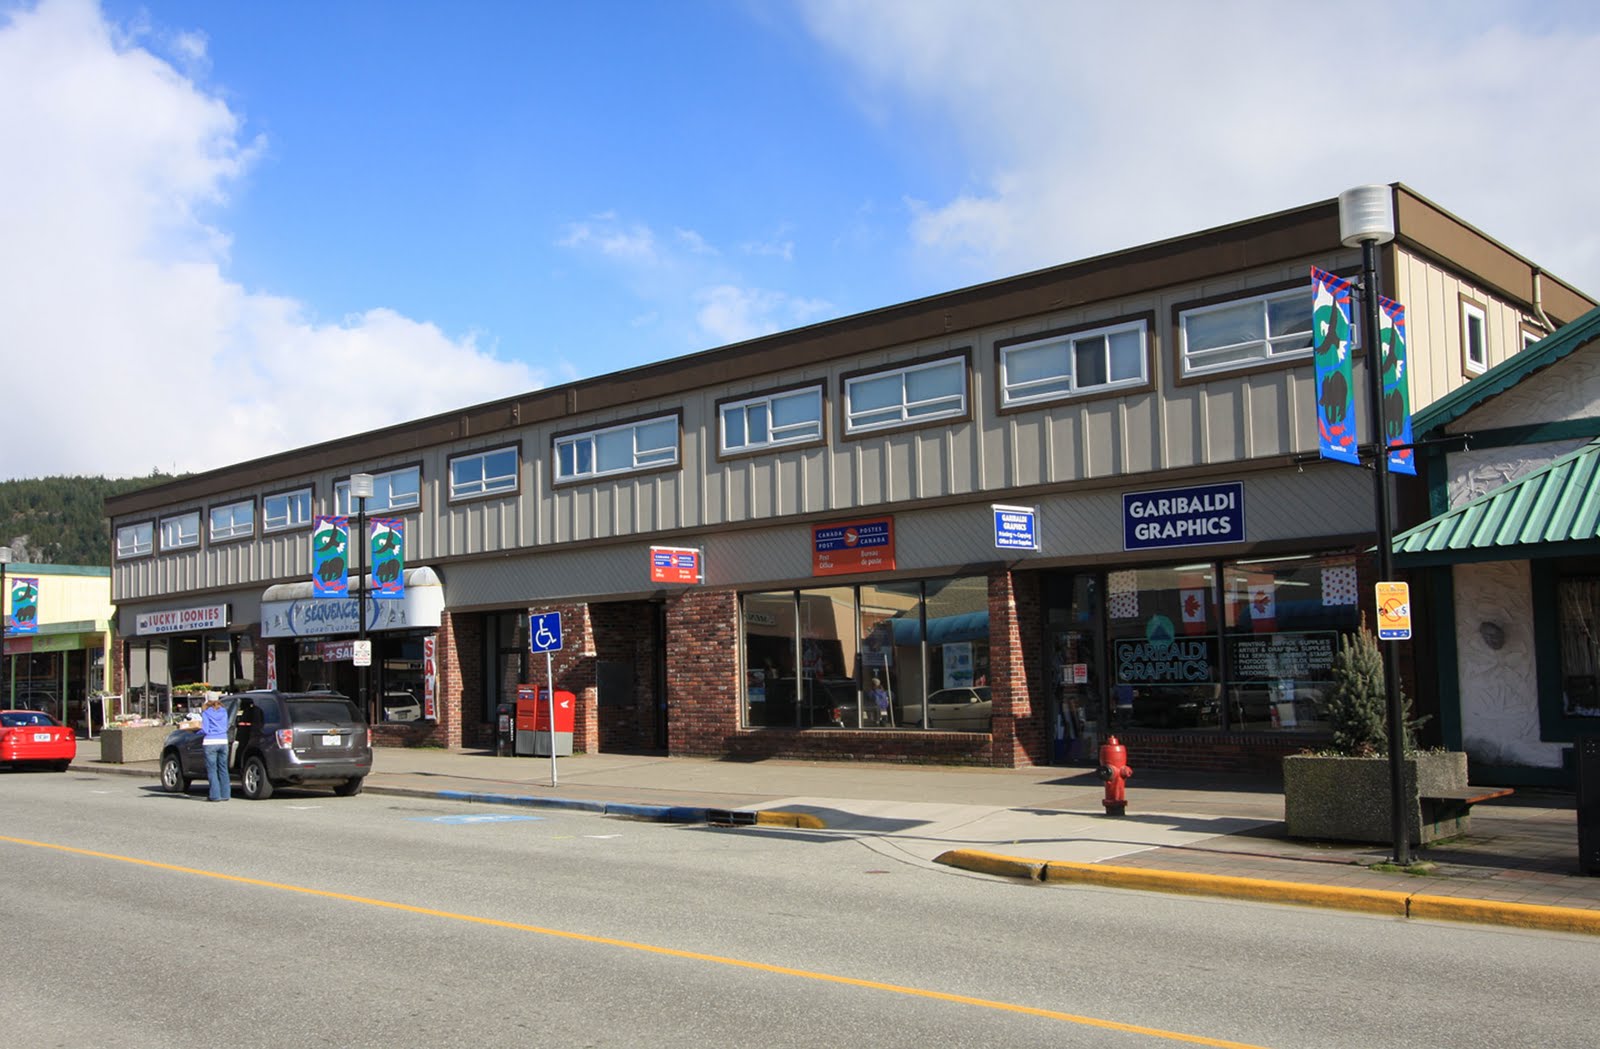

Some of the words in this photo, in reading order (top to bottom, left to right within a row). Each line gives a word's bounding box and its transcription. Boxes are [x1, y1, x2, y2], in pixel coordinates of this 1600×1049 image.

[1129, 492, 1235, 518] GARIBALDI
[1002, 514, 1028, 523] GARIBALDI
[1003, 522, 1027, 531] GRAPHICS
[1134, 516, 1232, 540] GRAPHICS
[149, 613, 177, 626] LUCKY
[180, 608, 219, 623] LOONIES
[304, 601, 359, 624] SEQUENCE
[155, 624, 184, 632] DOLLAR
[190, 621, 214, 629] STORE
[336, 647, 354, 659] SAL
[1118, 642, 1208, 663] GARIBALDI
[267, 648, 275, 690] SA
[424, 640, 434, 716] SALE
[1118, 660, 1209, 681] GRAPHICS
